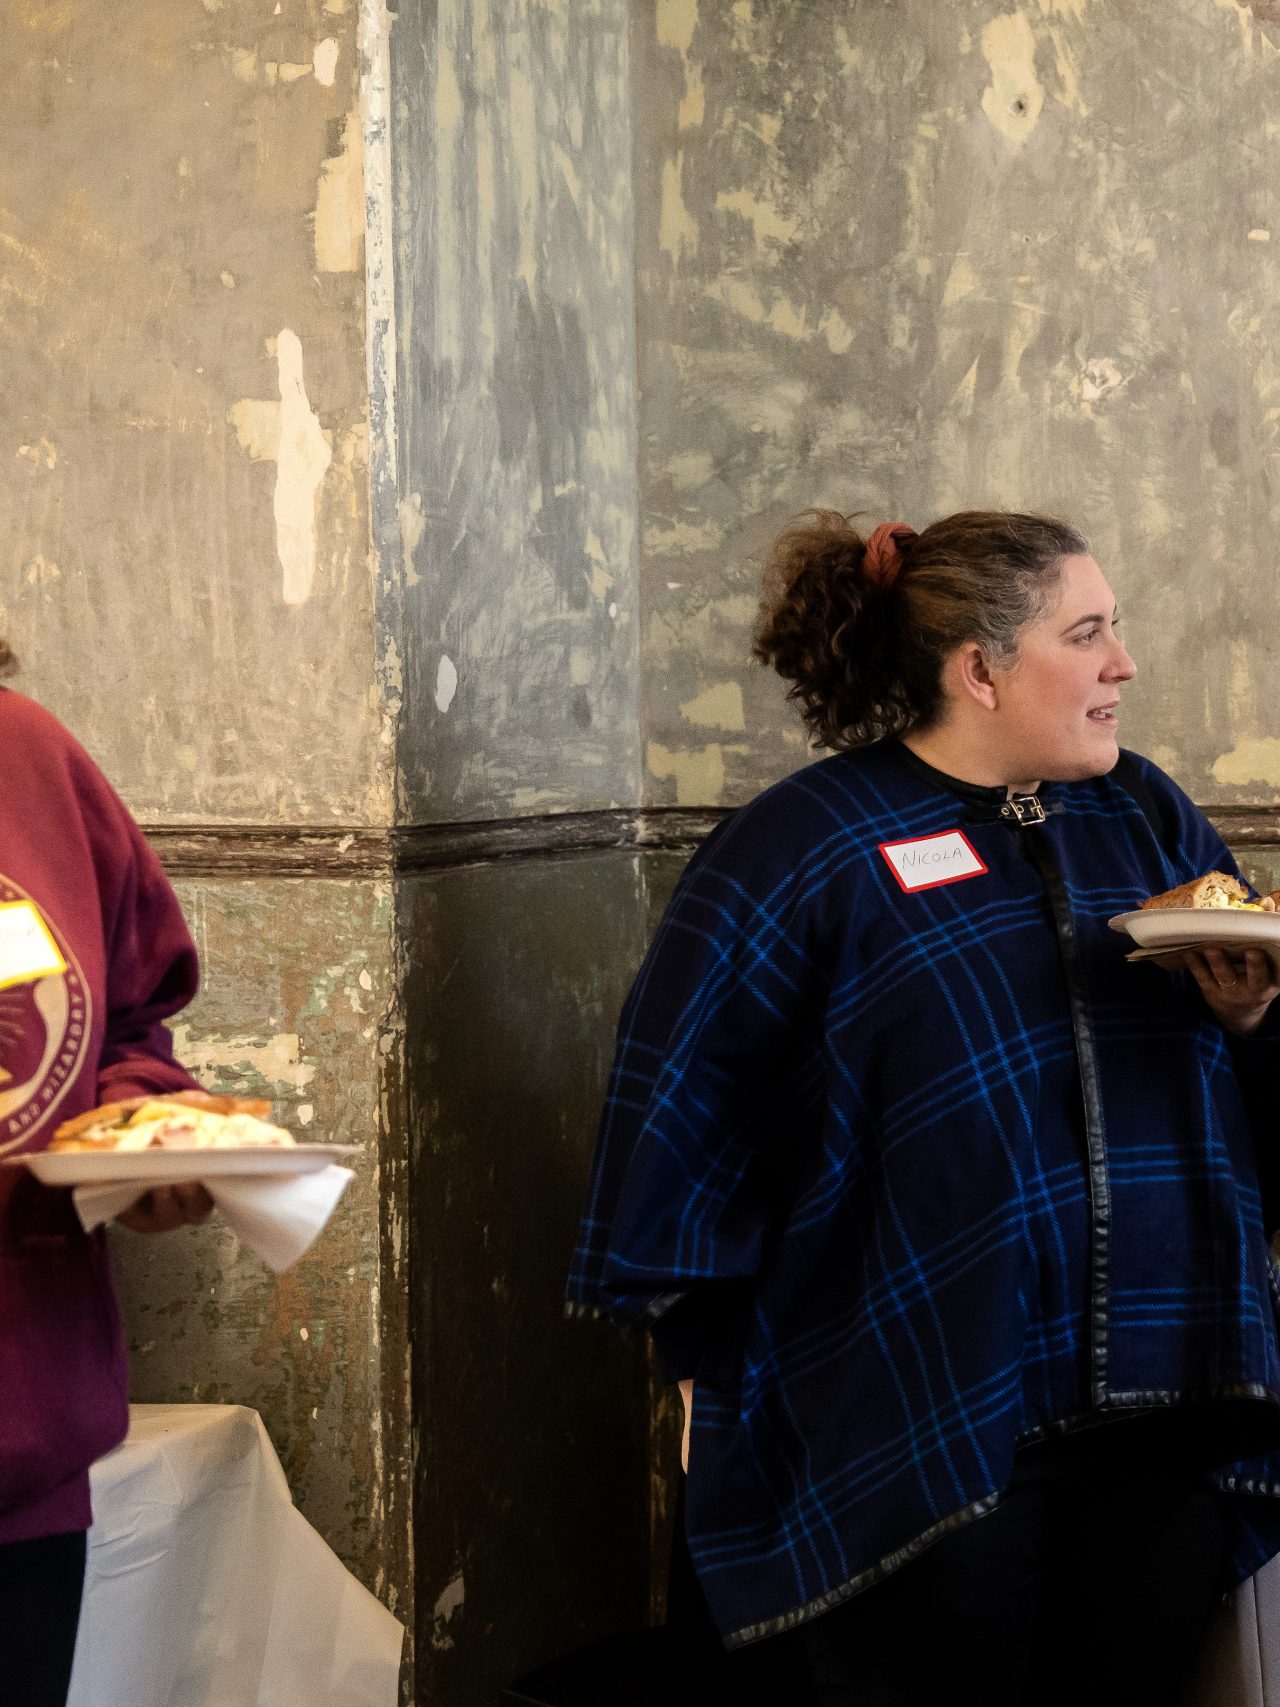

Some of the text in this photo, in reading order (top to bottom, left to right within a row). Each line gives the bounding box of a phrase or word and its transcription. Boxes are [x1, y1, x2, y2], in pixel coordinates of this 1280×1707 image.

[902, 847, 962, 869] NICOLA
[8, 993, 83, 1133] AND WIZARDRY
